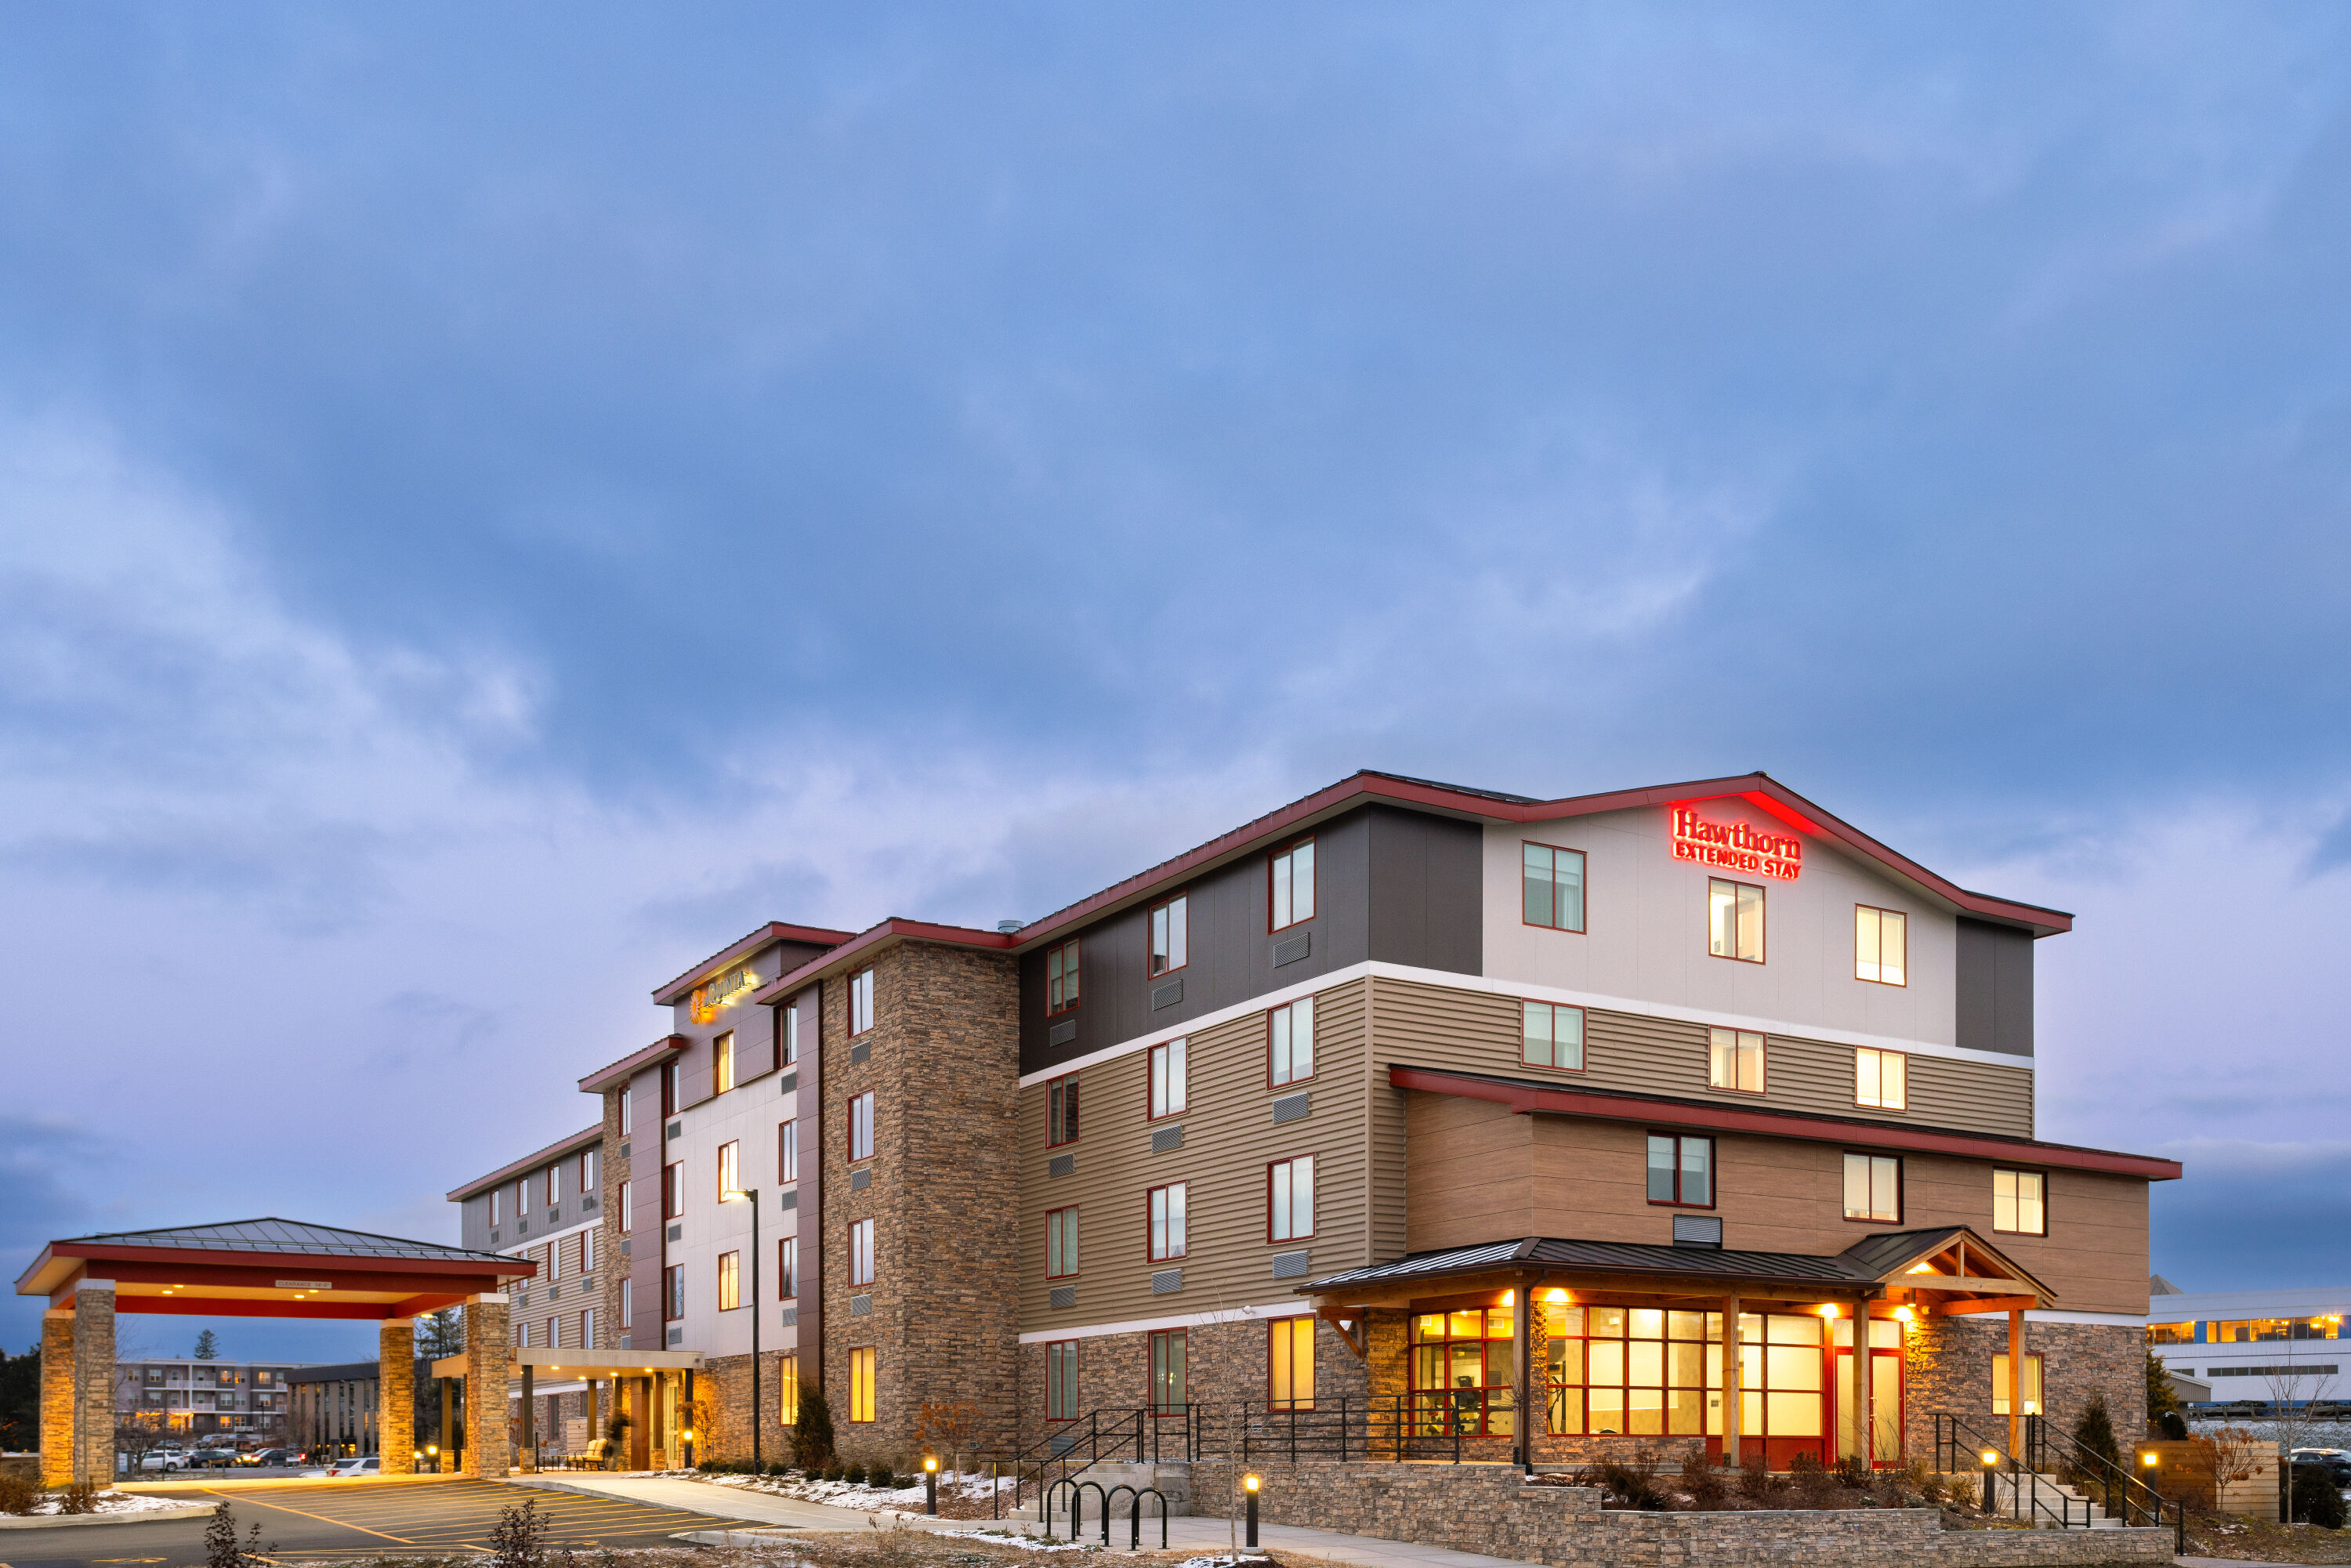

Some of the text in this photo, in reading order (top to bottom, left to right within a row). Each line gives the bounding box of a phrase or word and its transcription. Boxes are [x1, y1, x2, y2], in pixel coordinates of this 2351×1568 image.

[1674, 809, 1801, 860] Hawthorn
[1675, 842, 1802, 878] EXTENDED STAY
[708, 970, 745, 1005] QUINTA
